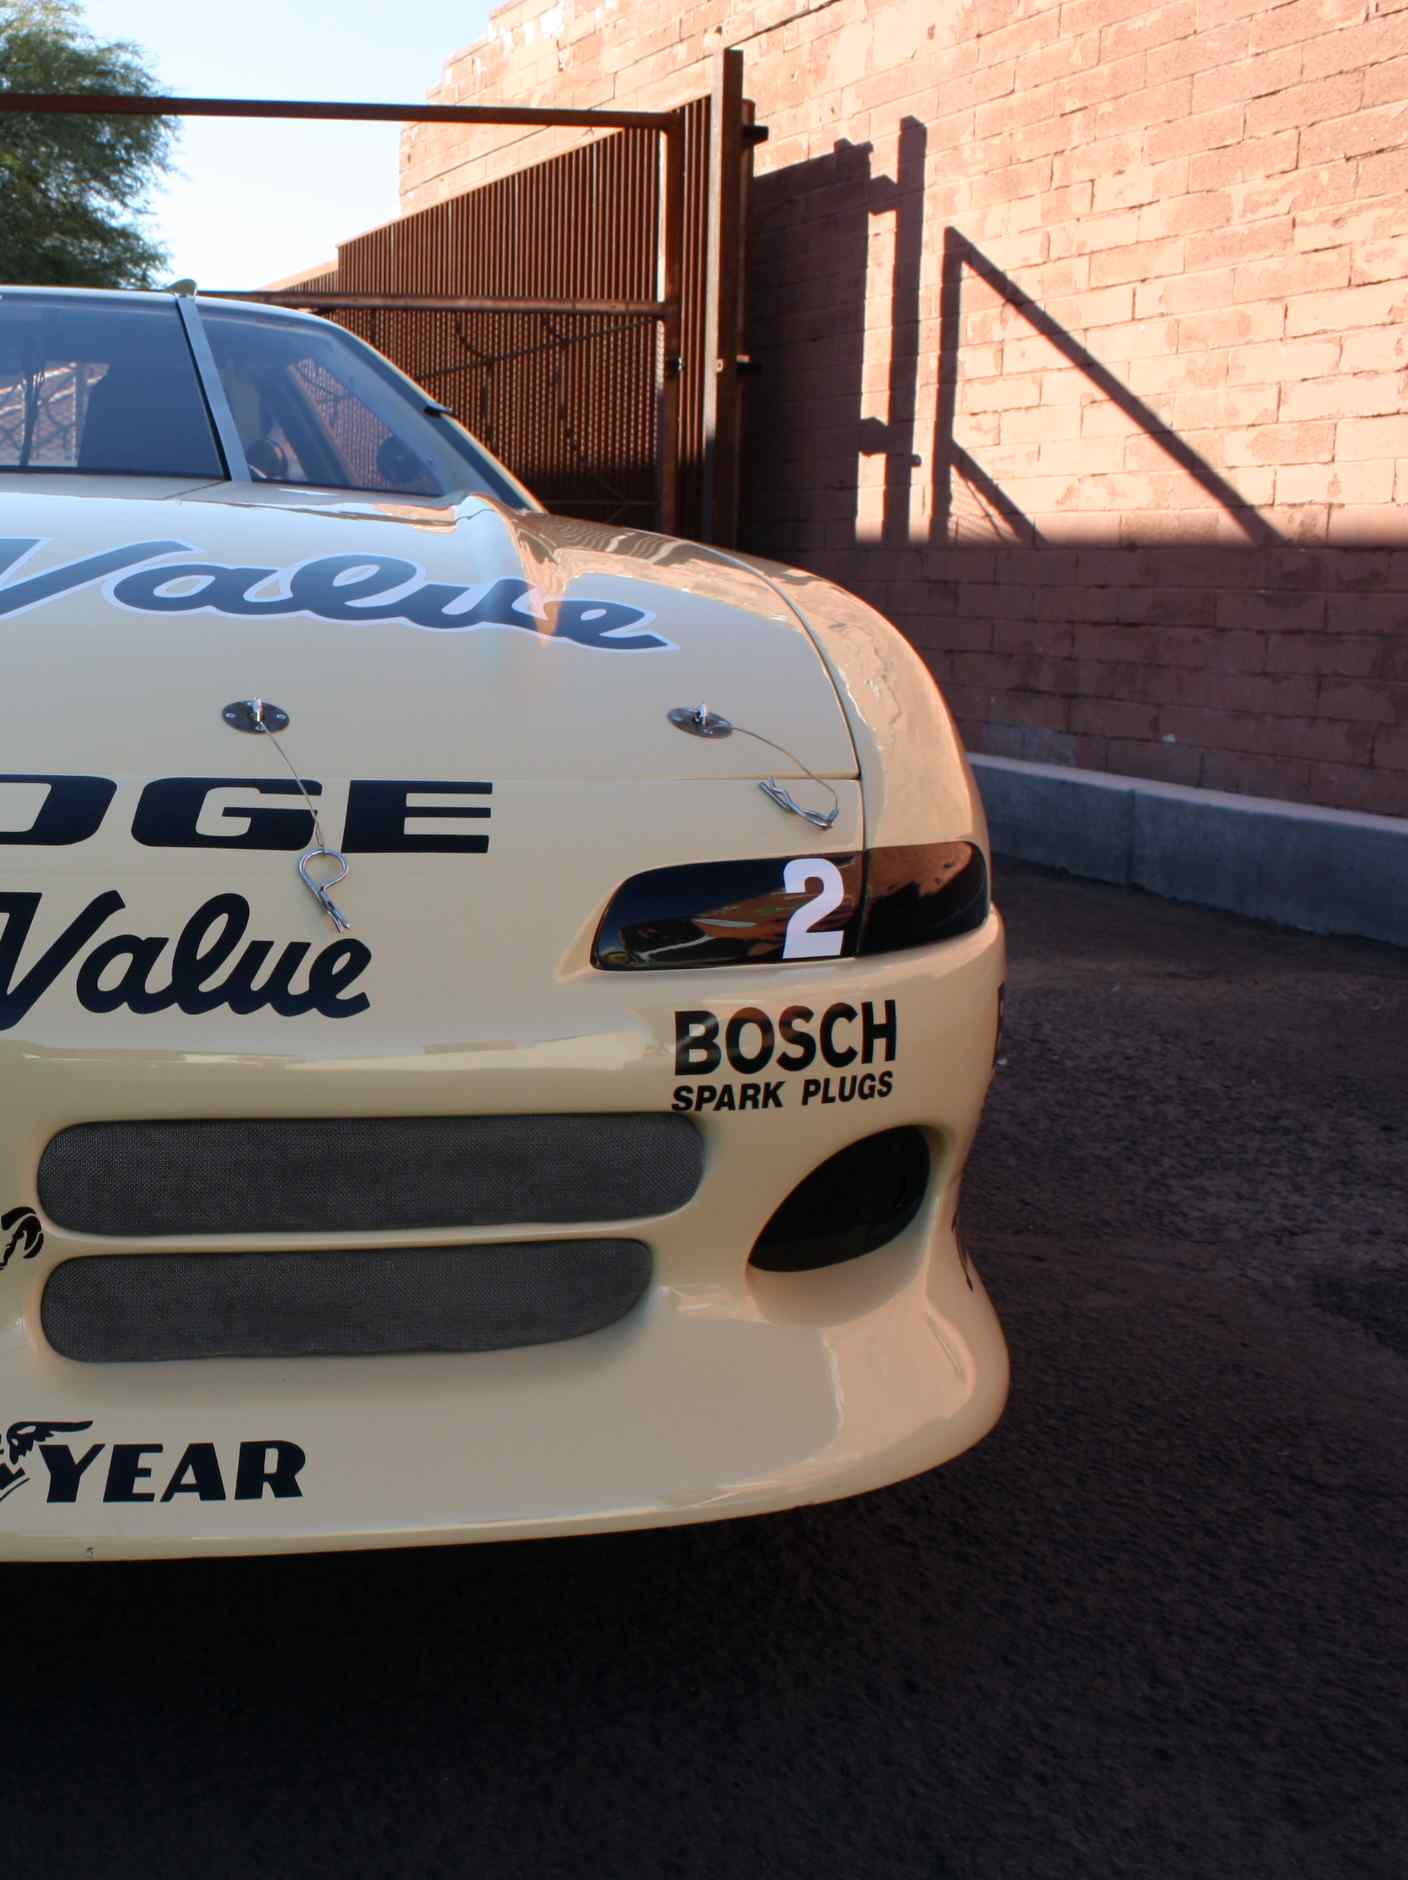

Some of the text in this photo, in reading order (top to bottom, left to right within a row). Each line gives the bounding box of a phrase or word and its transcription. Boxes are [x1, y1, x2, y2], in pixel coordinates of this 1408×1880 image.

[782, 857, 845, 960] 2
[674, 999, 898, 1077] BOSCH
[671, 1070, 894, 1113] SPARK PLUGS
